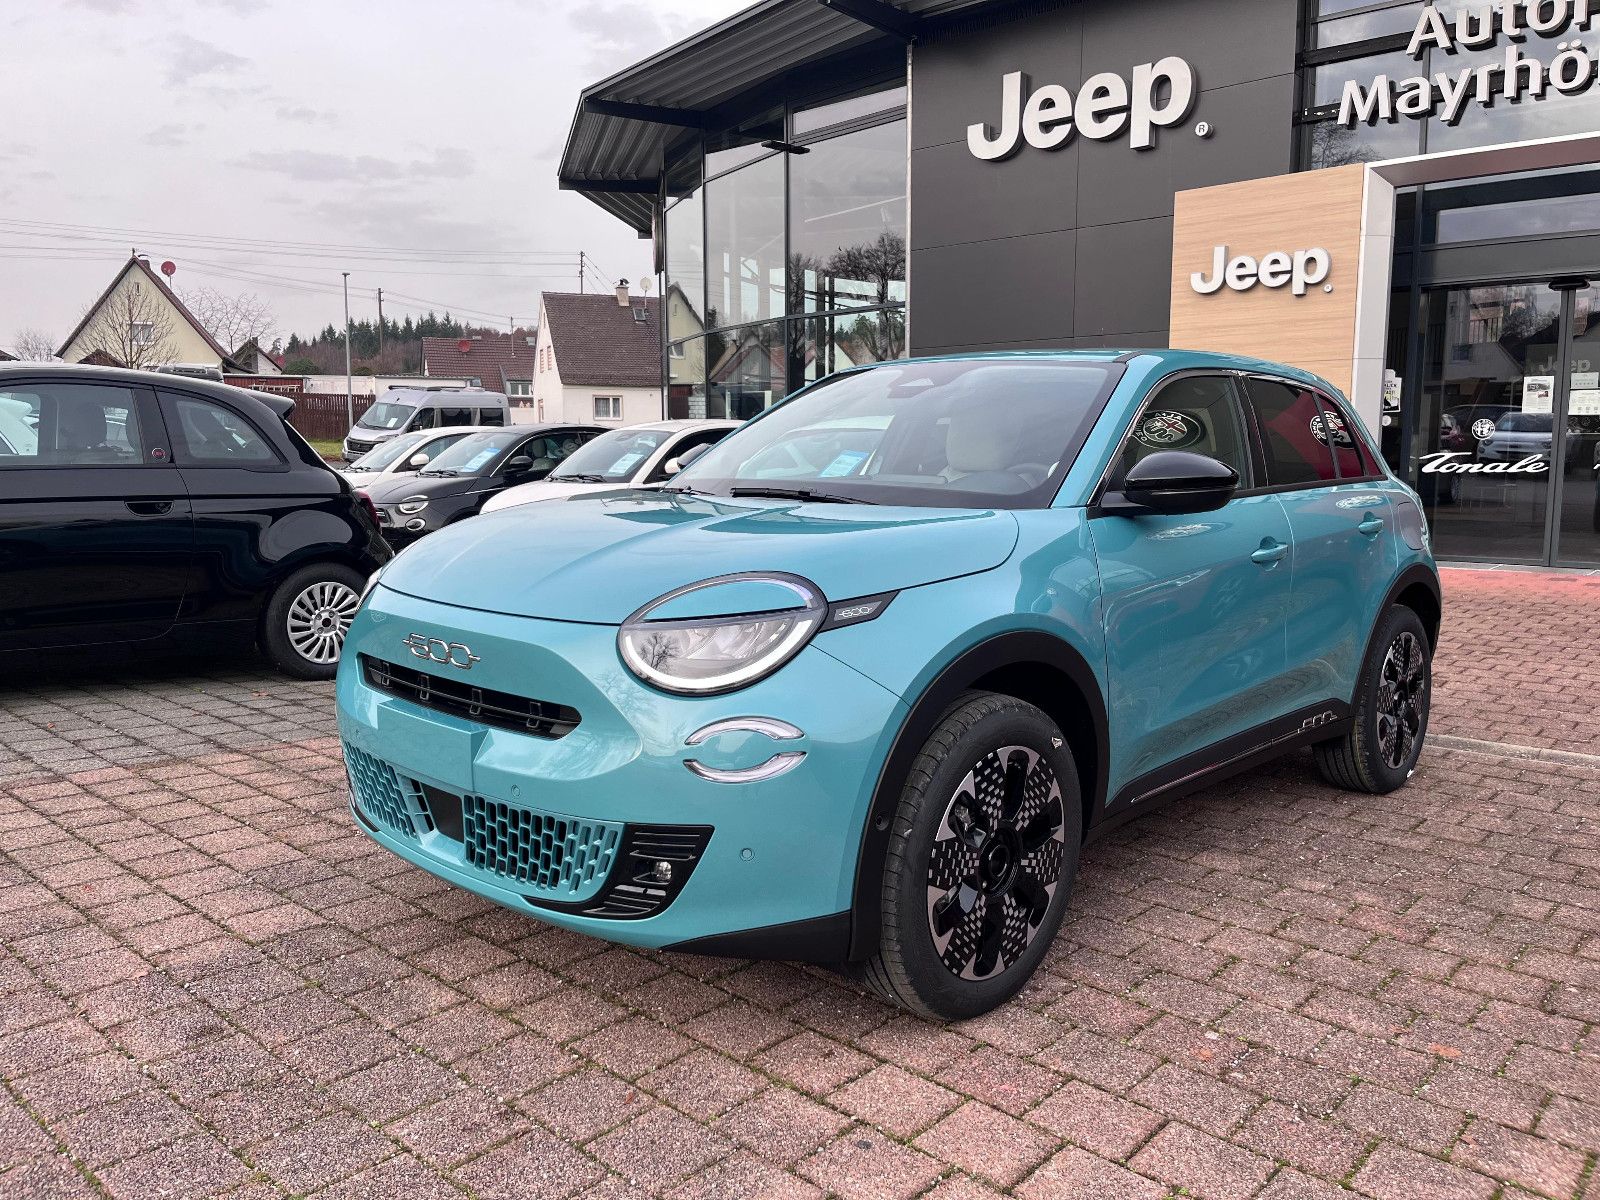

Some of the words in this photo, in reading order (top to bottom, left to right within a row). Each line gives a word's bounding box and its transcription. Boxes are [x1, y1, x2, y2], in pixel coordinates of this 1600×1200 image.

[1337, 39, 1600, 125] Mayrhö
[967, 56, 1195, 161] Jeep
[1190, 245, 1331, 296] Jeep
[1419, 452, 1549, 473] Tonale
[402, 632, 481, 670] 600
